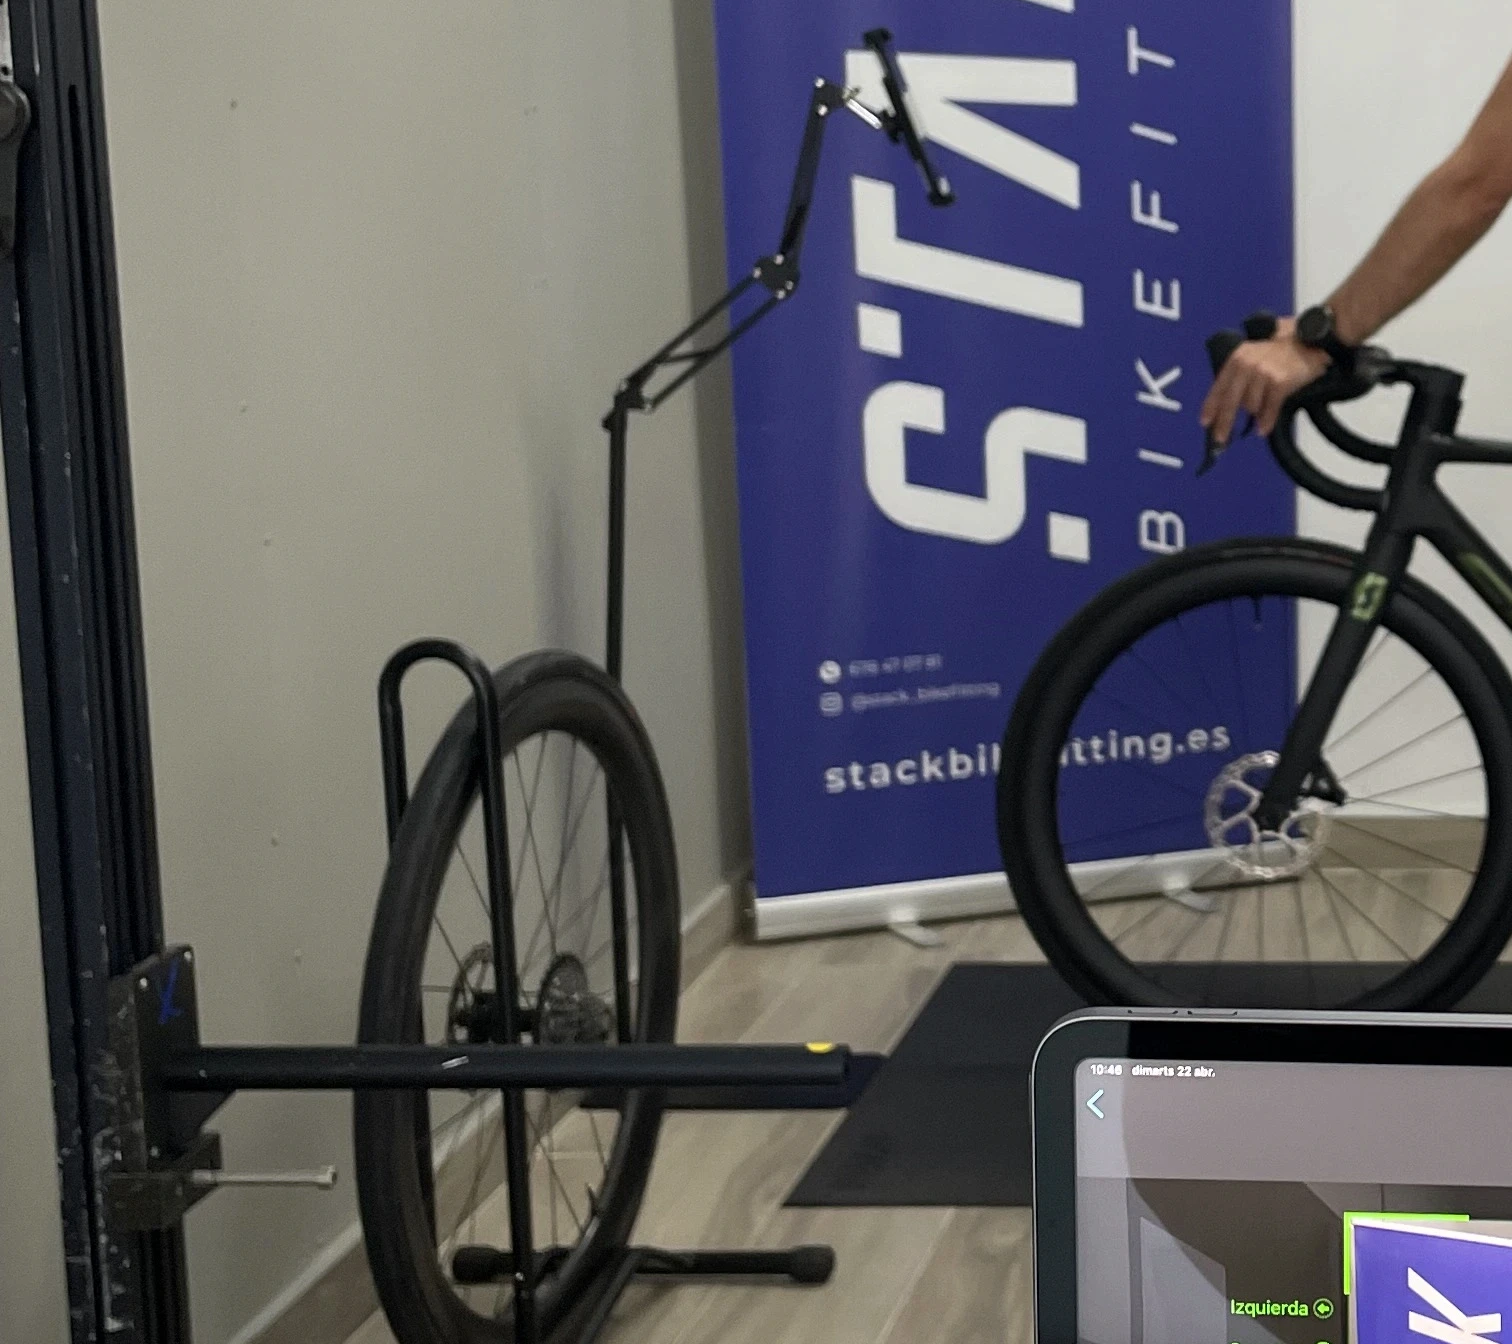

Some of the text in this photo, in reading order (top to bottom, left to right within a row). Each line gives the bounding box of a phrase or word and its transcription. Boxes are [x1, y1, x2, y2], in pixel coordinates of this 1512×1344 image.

[823, 725, 1231, 794] stackbiitting.es
[1131, 1064, 1175, 1077] dimarts
[1176, 1065, 1192, 1077] 22
[1193, 1066, 1216, 1078] abr.
[1230, 1299, 1309, 1318] Izquierda
